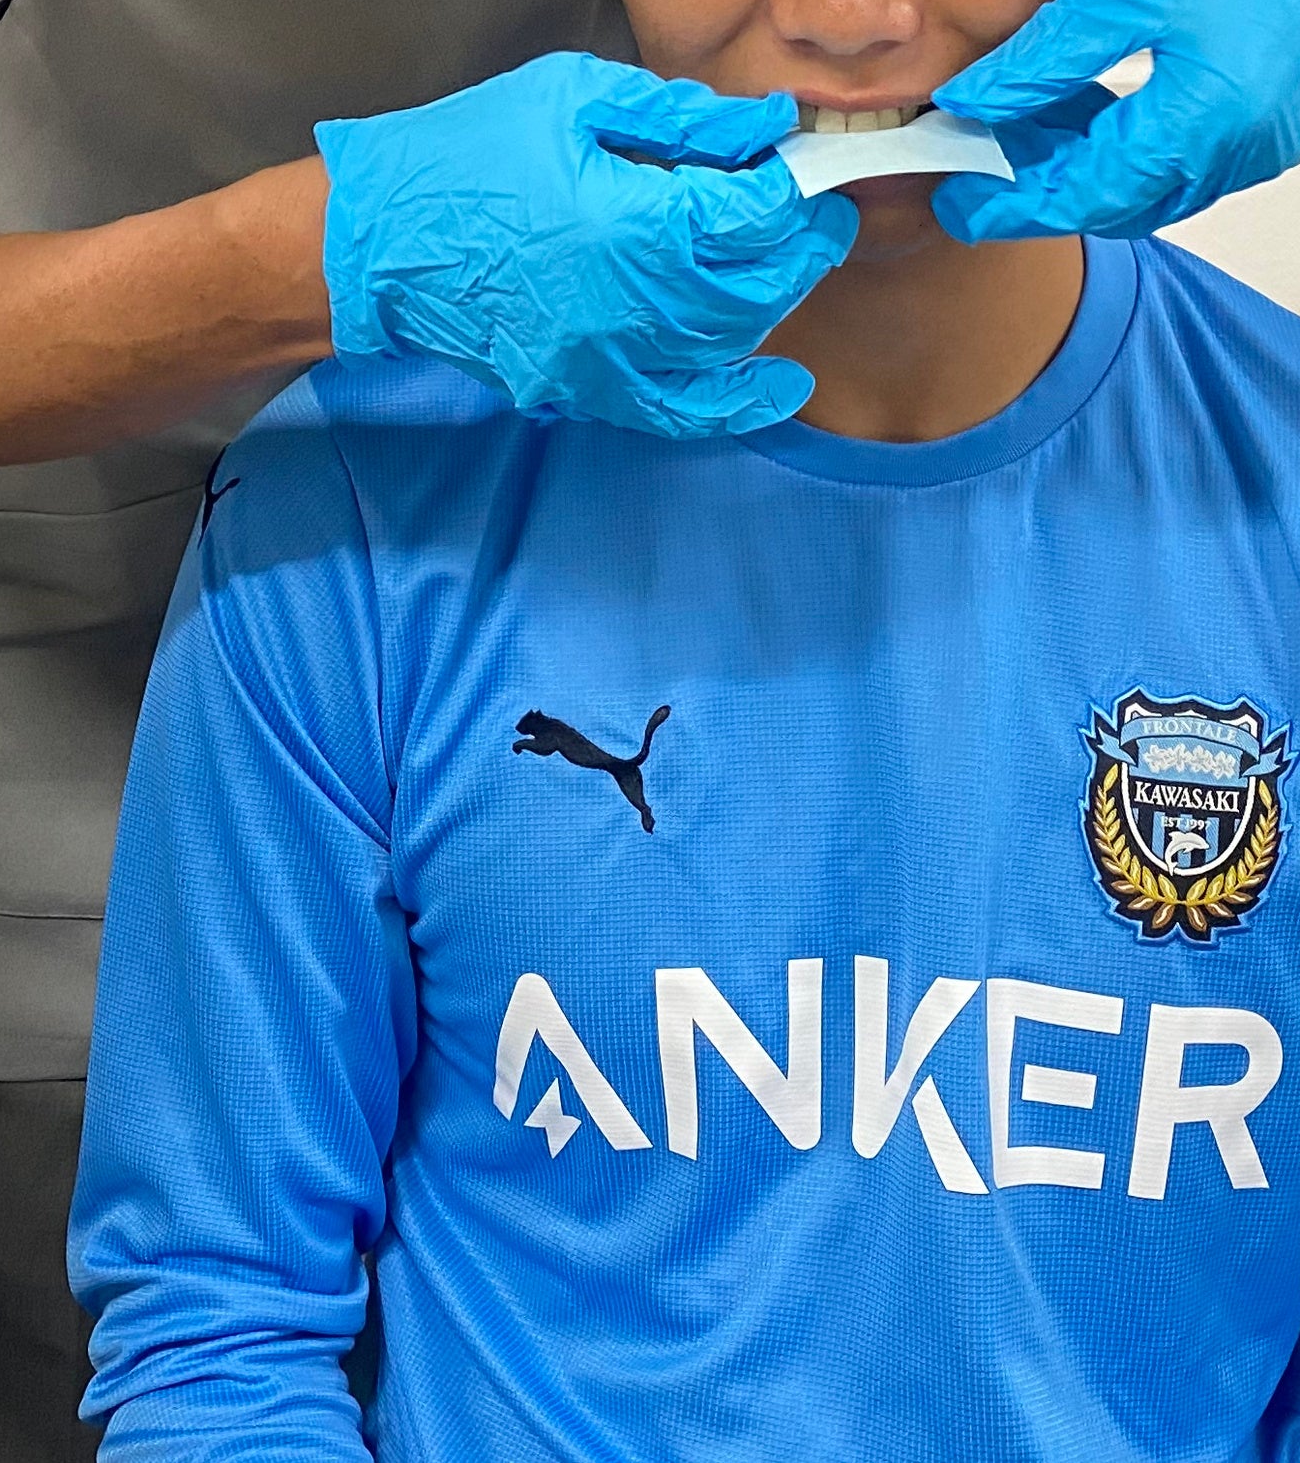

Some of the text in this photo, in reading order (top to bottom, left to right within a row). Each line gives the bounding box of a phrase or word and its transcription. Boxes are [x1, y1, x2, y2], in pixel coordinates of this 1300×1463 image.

[1143, 719, 1238, 743] FRONTALE
[1134, 780, 1240, 813] KAWASAKI
[1161, 816, 1183, 828] EST
[493, 955, 1284, 1201] ANKER
